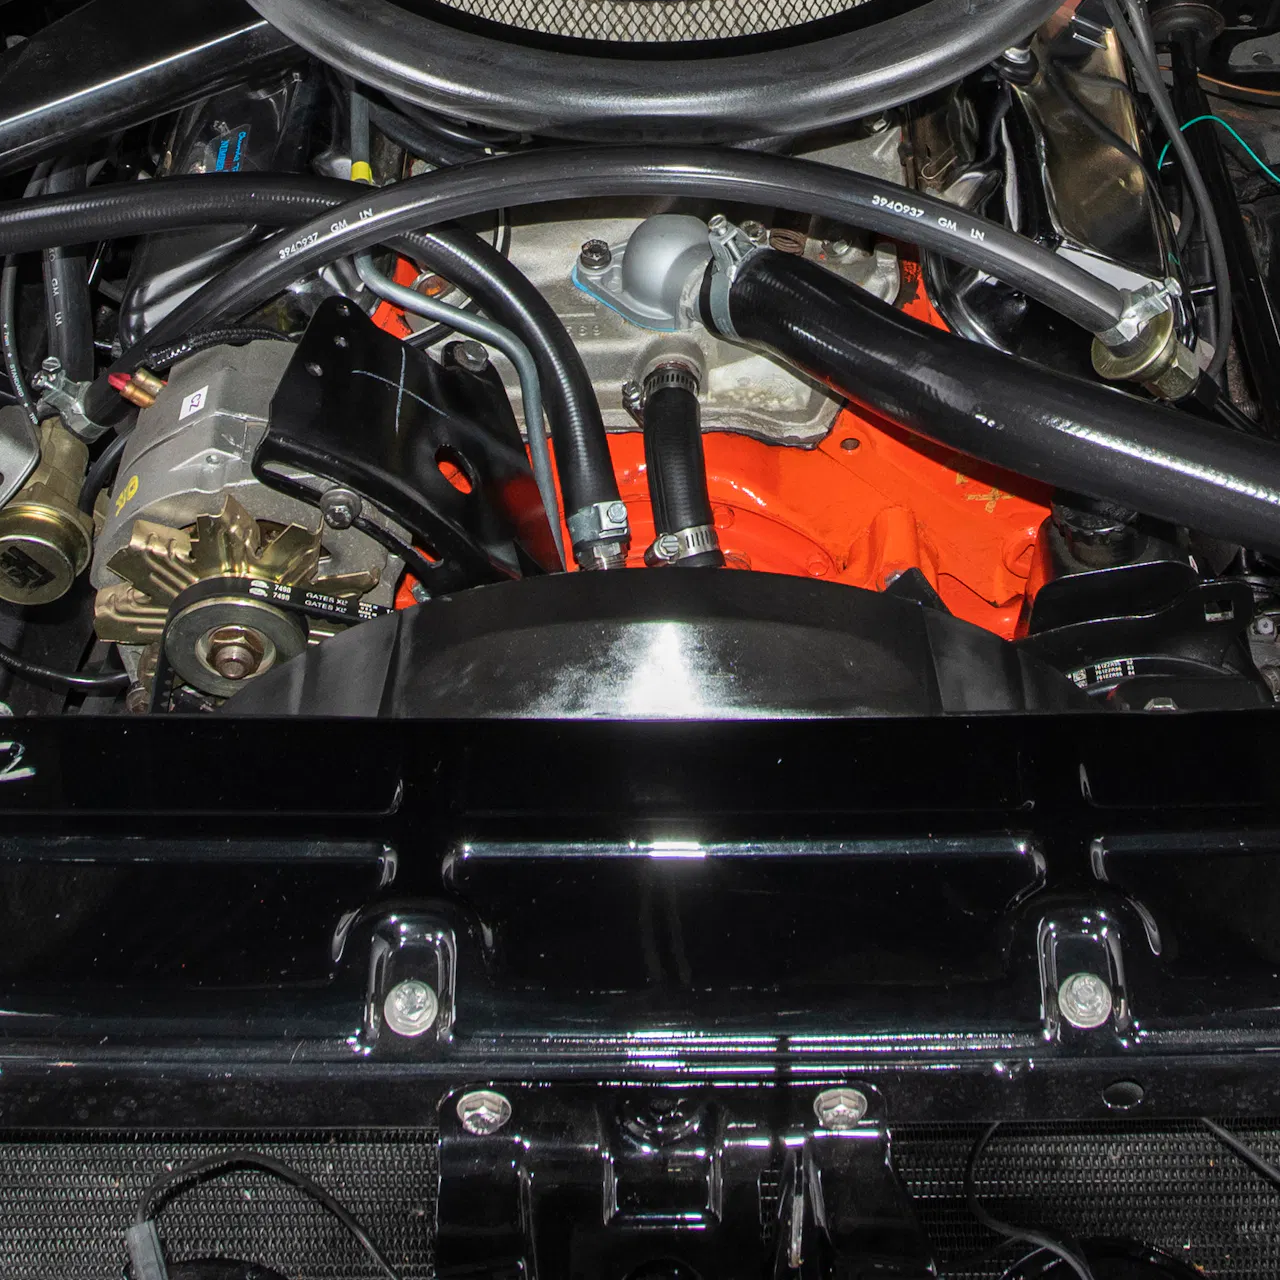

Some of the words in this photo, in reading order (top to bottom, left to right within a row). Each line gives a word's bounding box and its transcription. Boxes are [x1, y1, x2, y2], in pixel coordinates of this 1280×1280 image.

[872, 194, 924, 218] 3940937
[938, 217, 957, 231] GM
[970, 228, 985, 241] LN
[279, 232, 319, 260] 3940937
[330, 219, 348, 234] GM
[51, 277, 60, 297] GM
[9, 363, 25, 398] STANDARD
[304, 599, 333, 611] GATES
[305, 592, 335, 604] GATES
